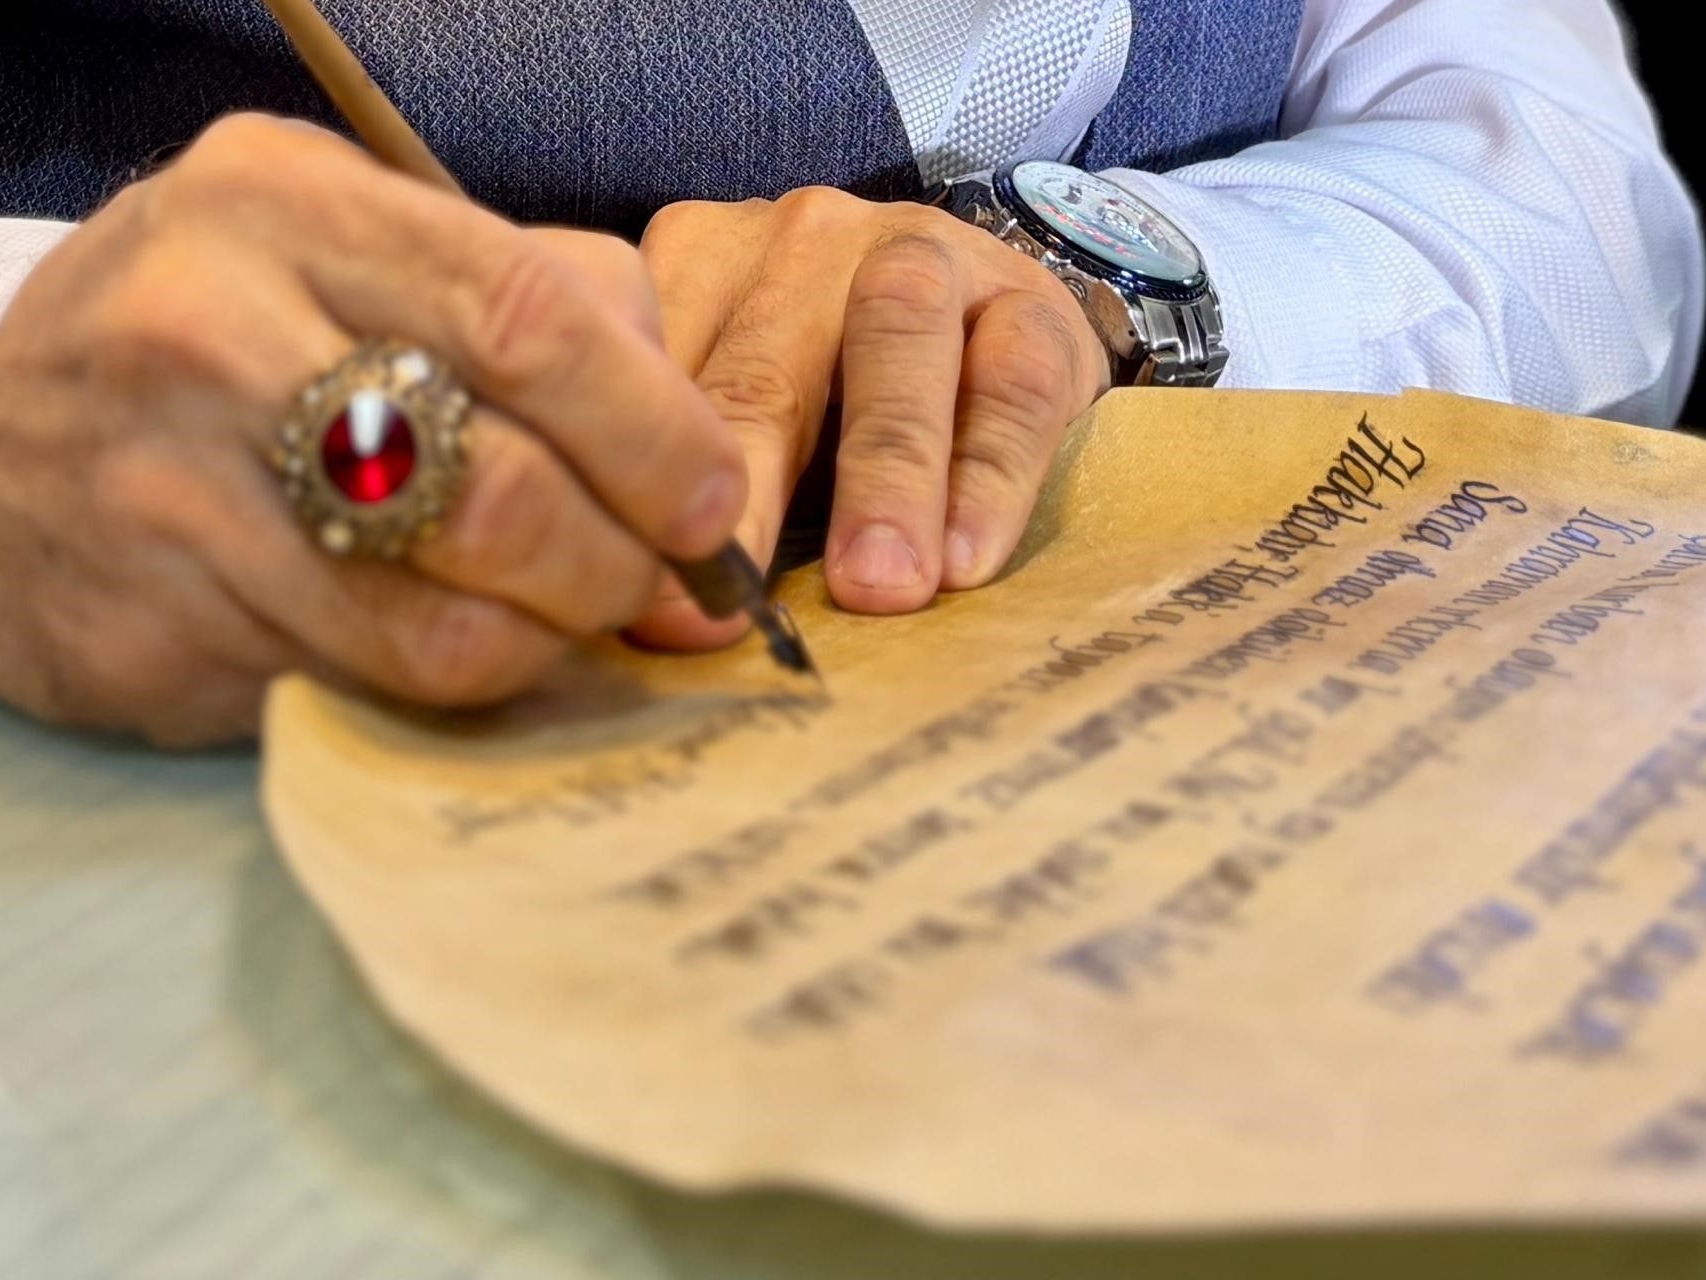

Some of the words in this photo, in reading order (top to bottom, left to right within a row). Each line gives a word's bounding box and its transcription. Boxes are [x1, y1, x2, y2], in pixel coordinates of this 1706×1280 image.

[1401, 480, 1528, 550] Sana
[1311, 550, 1437, 608] olmaz
[1452, 507, 1655, 607] Kahraman
